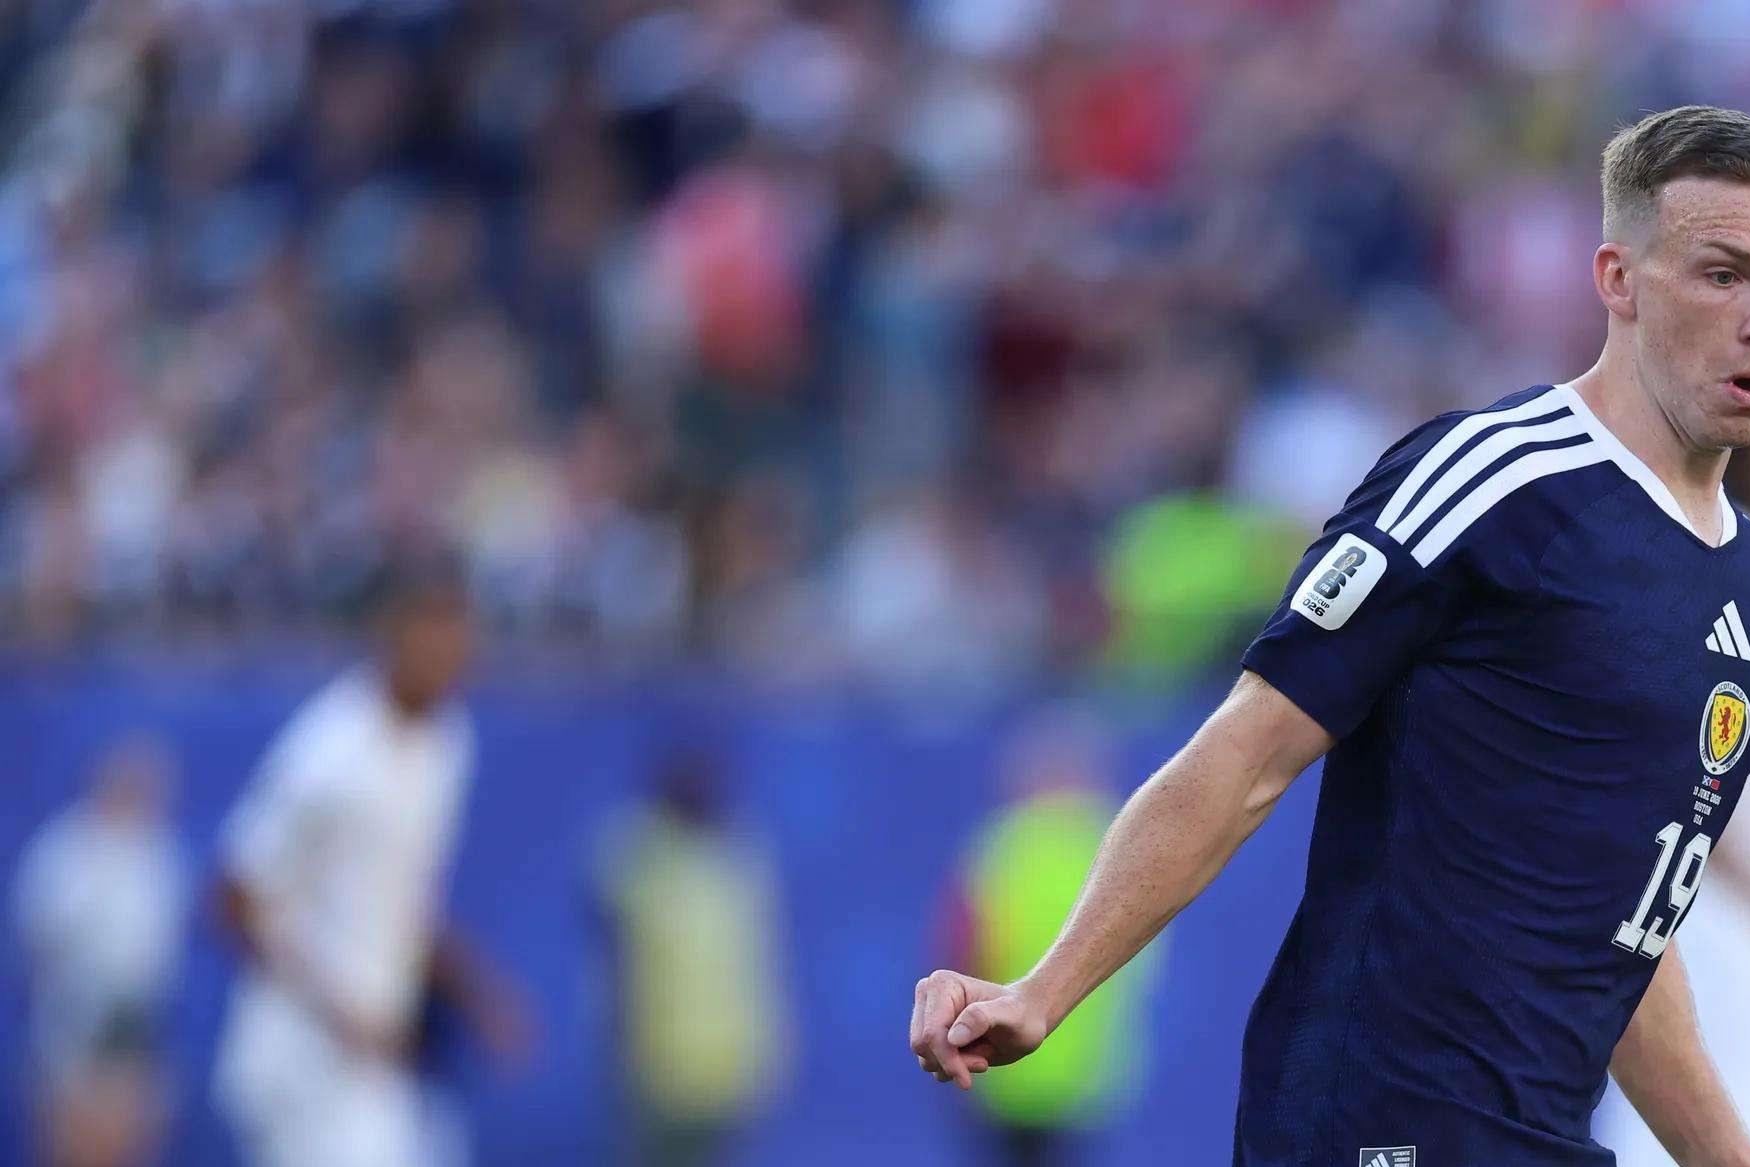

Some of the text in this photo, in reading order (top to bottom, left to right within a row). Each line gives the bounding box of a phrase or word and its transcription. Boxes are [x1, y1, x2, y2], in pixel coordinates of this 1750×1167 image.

[1302, 598, 1326, 617] 026
[1717, 682, 1744, 699] SCOTLAND
[1611, 821, 1712, 960] 19
